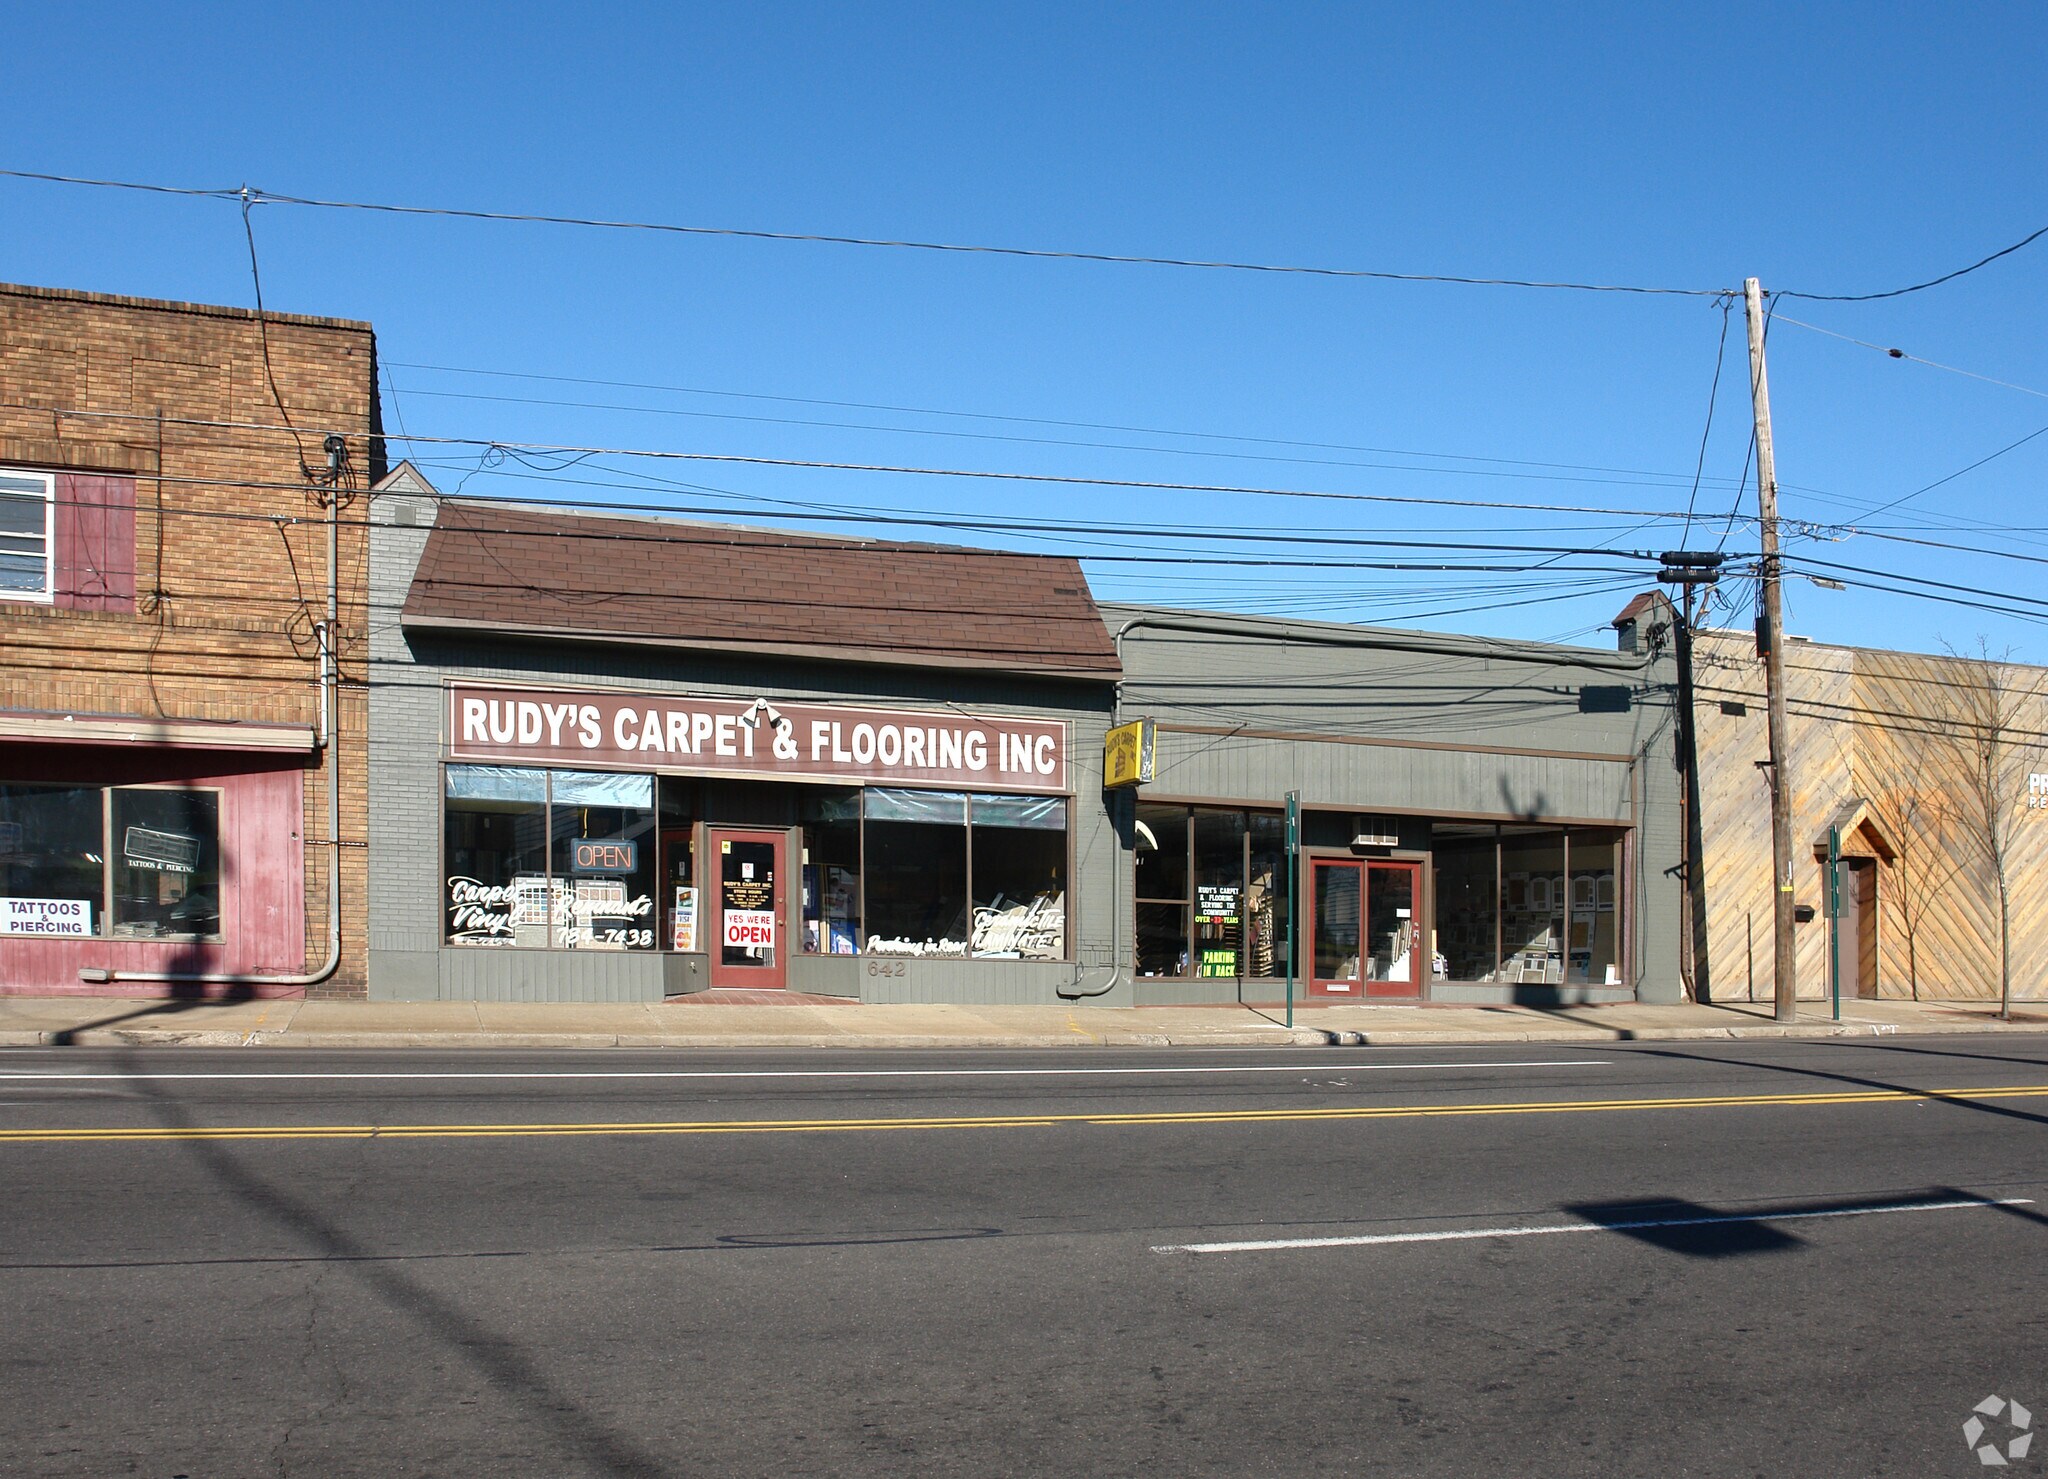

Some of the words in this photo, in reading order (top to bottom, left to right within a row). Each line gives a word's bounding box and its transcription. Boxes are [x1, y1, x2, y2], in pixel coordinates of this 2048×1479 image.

[462, 697, 603, 749] RUDY'S
[613, 706, 761, 757] CARPET
[772, 717, 799, 760] &
[811, 720, 988, 771] FLOORING
[1000, 732, 1056, 775] INC
[577, 845, 632, 868] OPEN
[128, 860, 155, 868] TATTOOS
[166, 864, 195, 873] PIERCING
[1198, 886, 1217, 894] RUDY'S
[1219, 887, 1239, 895] CARPET
[9, 901, 81, 916] TATTOOS
[556, 894, 653, 918] Remnants
[41, 914, 49, 922] &
[728, 915, 744, 924] YES
[10, 921, 82, 934] PIERCING
[729, 926, 771, 943] OPEN
[557, 926, 653, 946] 784-7438
[866, 934, 925, 957] Parking
[1203, 951, 1235, 964] PARKING
[867, 961, 906, 978] 642
[1203, 964, 1212, 977] IN
[1215, 965, 1236, 977] BACK
